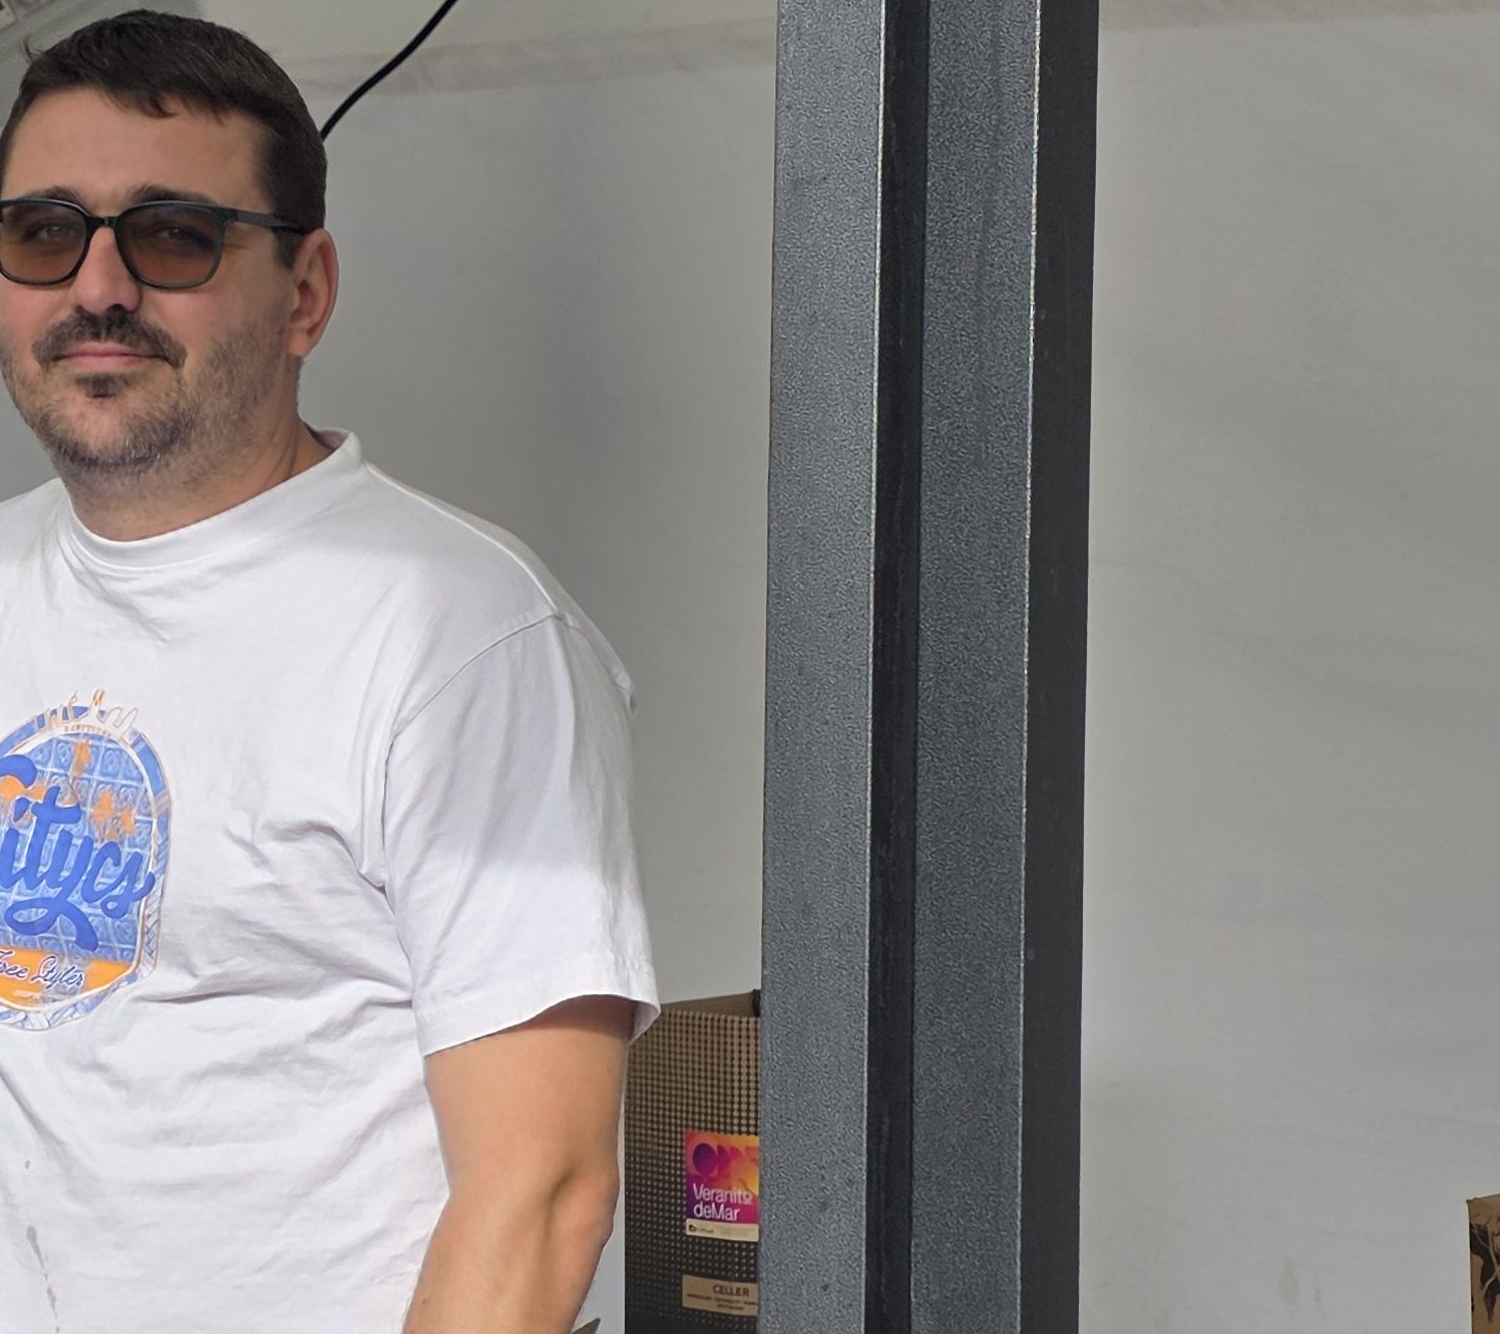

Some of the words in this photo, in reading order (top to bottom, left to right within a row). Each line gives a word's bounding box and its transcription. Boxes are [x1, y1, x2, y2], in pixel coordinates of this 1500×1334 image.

[693, 1182, 754, 1205] Veranito
[693, 1201, 741, 1221] deMar
[713, 1284, 750, 1298] CELLER
